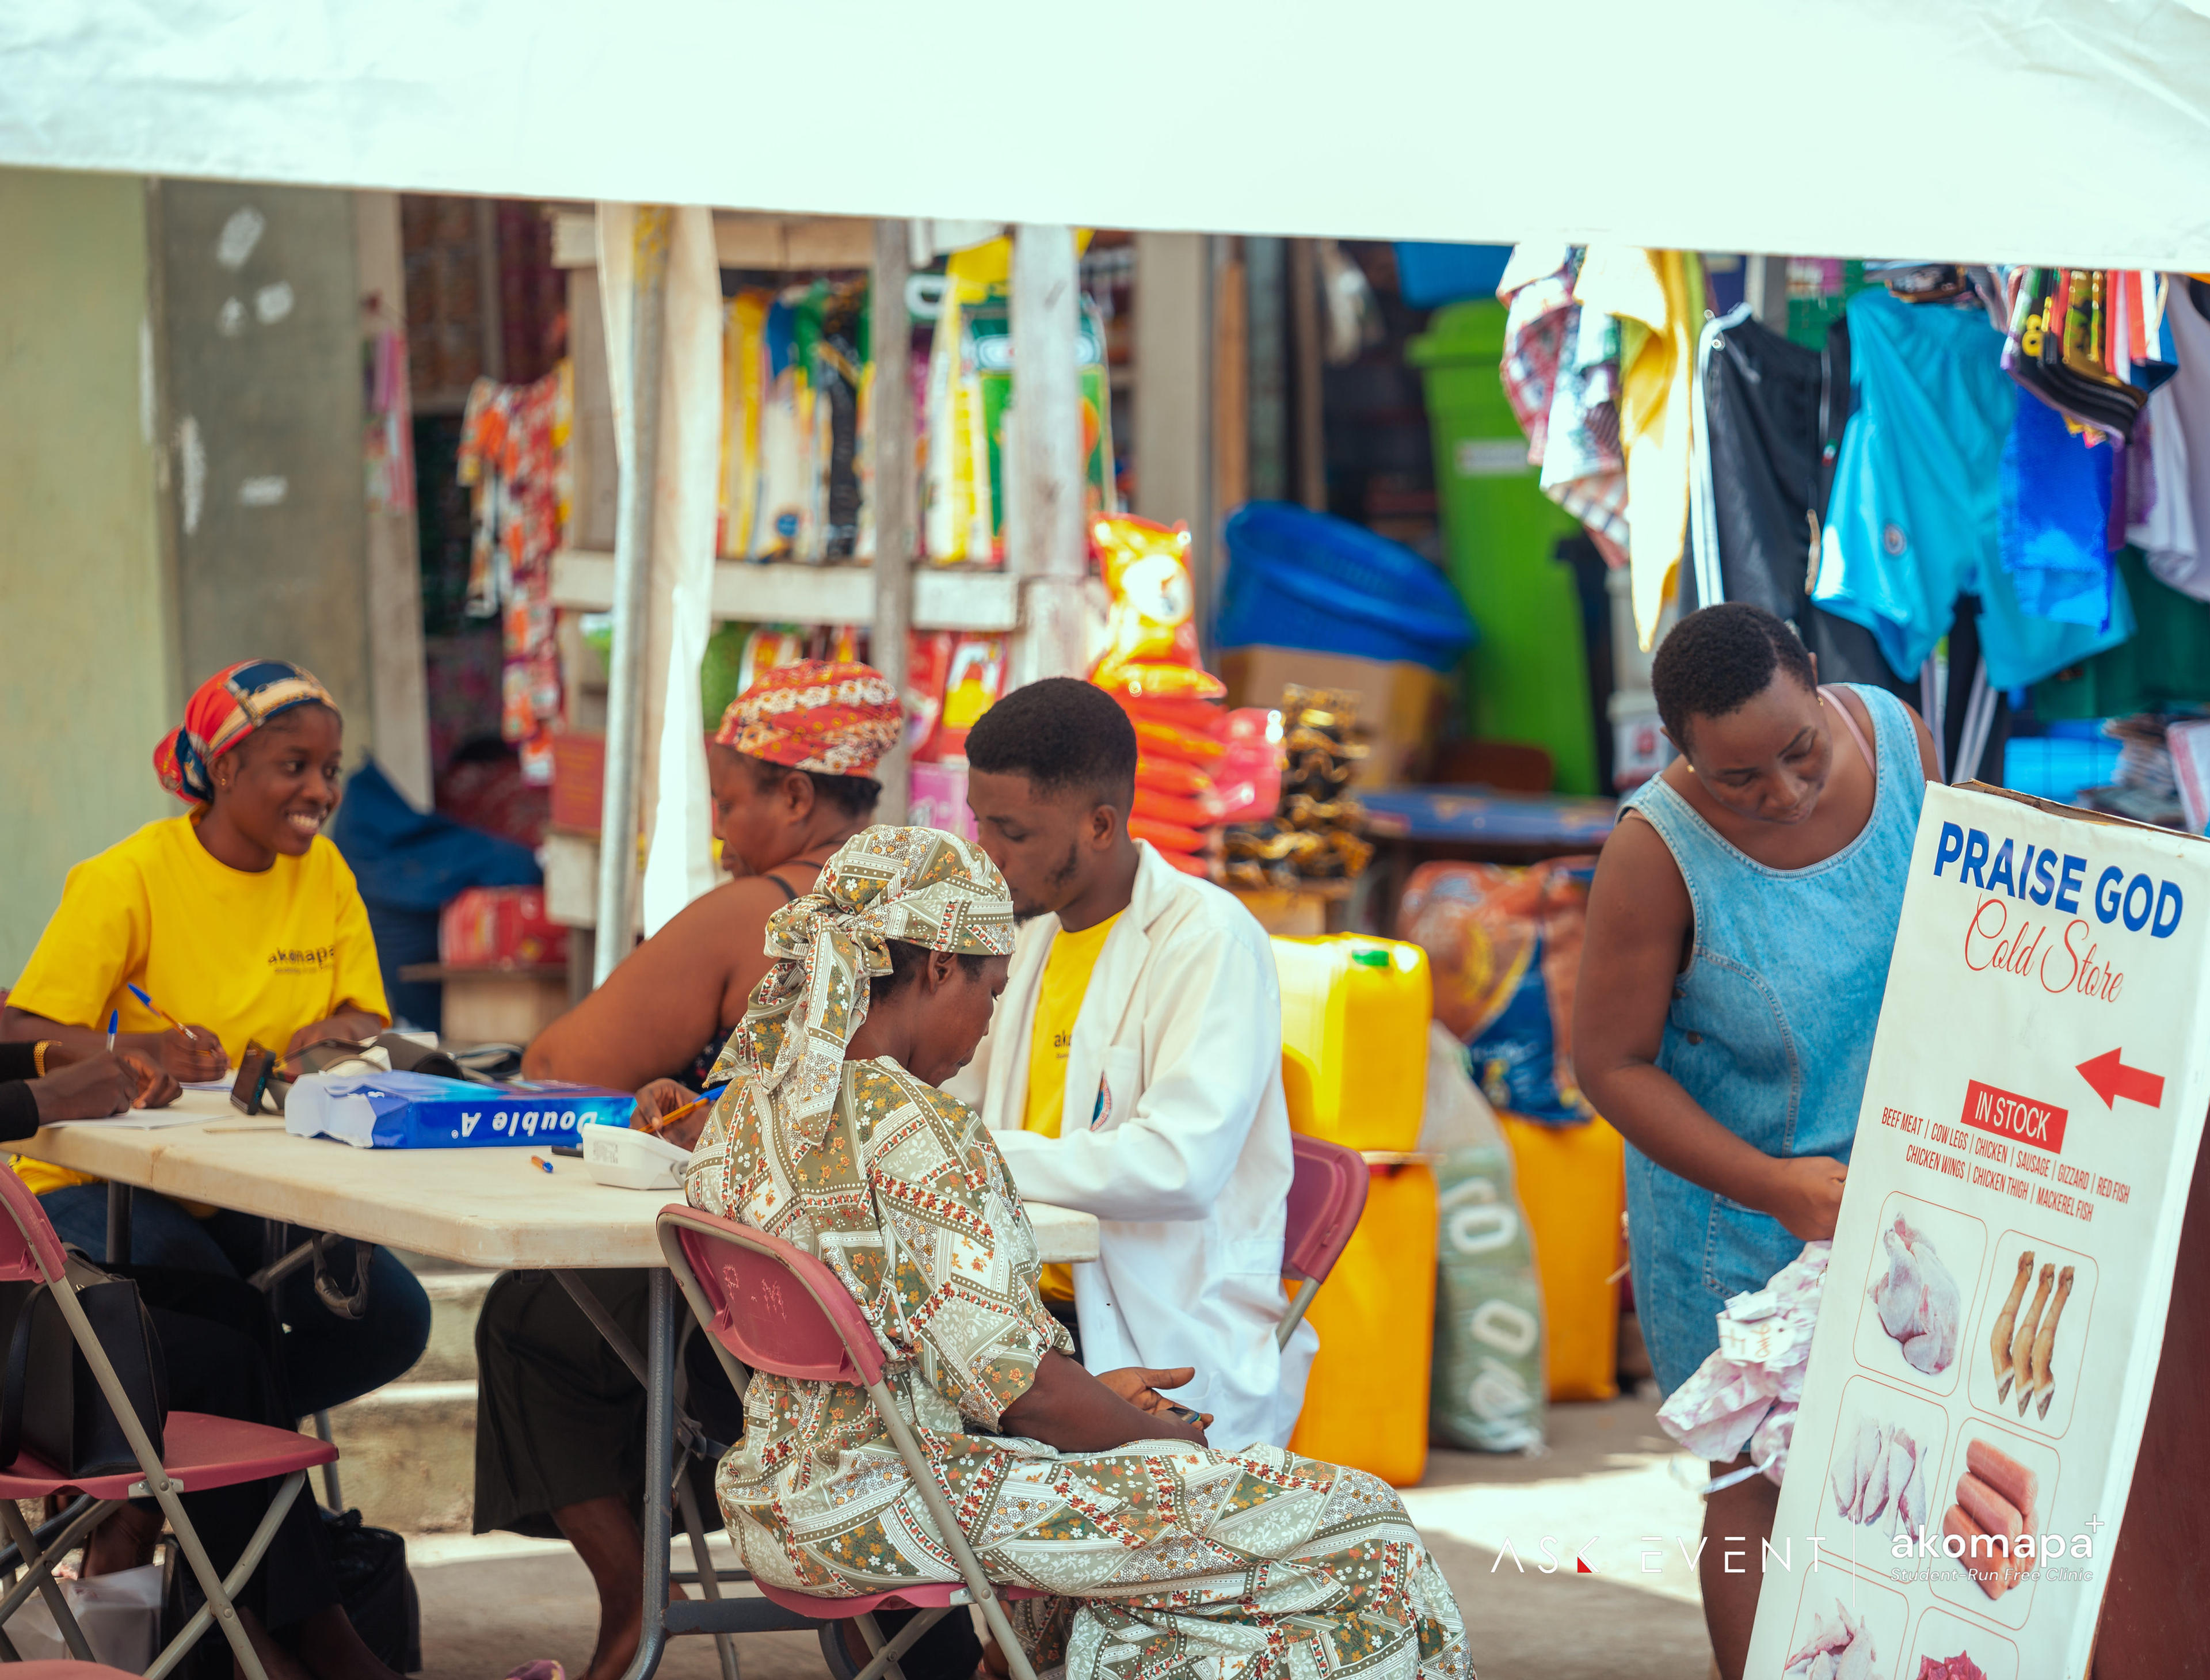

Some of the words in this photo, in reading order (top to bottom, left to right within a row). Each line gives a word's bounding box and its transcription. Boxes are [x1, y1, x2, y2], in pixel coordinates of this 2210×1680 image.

[1933, 821, 2087, 915] PRAISE
[2095, 865, 2184, 939] GOD
[1965, 893, 2047, 977] Cold
[2041, 919, 2124, 1003] Store
[492, 1111, 598, 1137] Double
[1881, 1107, 1902, 1128] BEEF
[1900, 1113, 1923, 1136] MEAT
[1931, 1123, 1950, 1144] COW
[1949, 1128, 1968, 1150] LEGS
[1975, 1137, 2008, 1164] CHICKEN
[2016, 1150, 2051, 1177] SAUSAGE
[2057, 1163, 2090, 1190] GIZZARD
[2097, 1176, 2113, 1198] RED
[2112, 1182, 2131, 1205] FISH
[1975, 1091, 1994, 1123] IN
[1994, 1097, 2051, 1141] STOCK
[1906, 1144, 1941, 1171] CHICKEN
[1941, 1155, 1965, 1179] WINGS
[1973, 1166, 2006, 1193] CHICKEN
[2007, 1176, 2029, 1200] THIGH
[2036, 1186, 2075, 1217] MACKEREL
[2075, 1200, 2094, 1222] FISH
